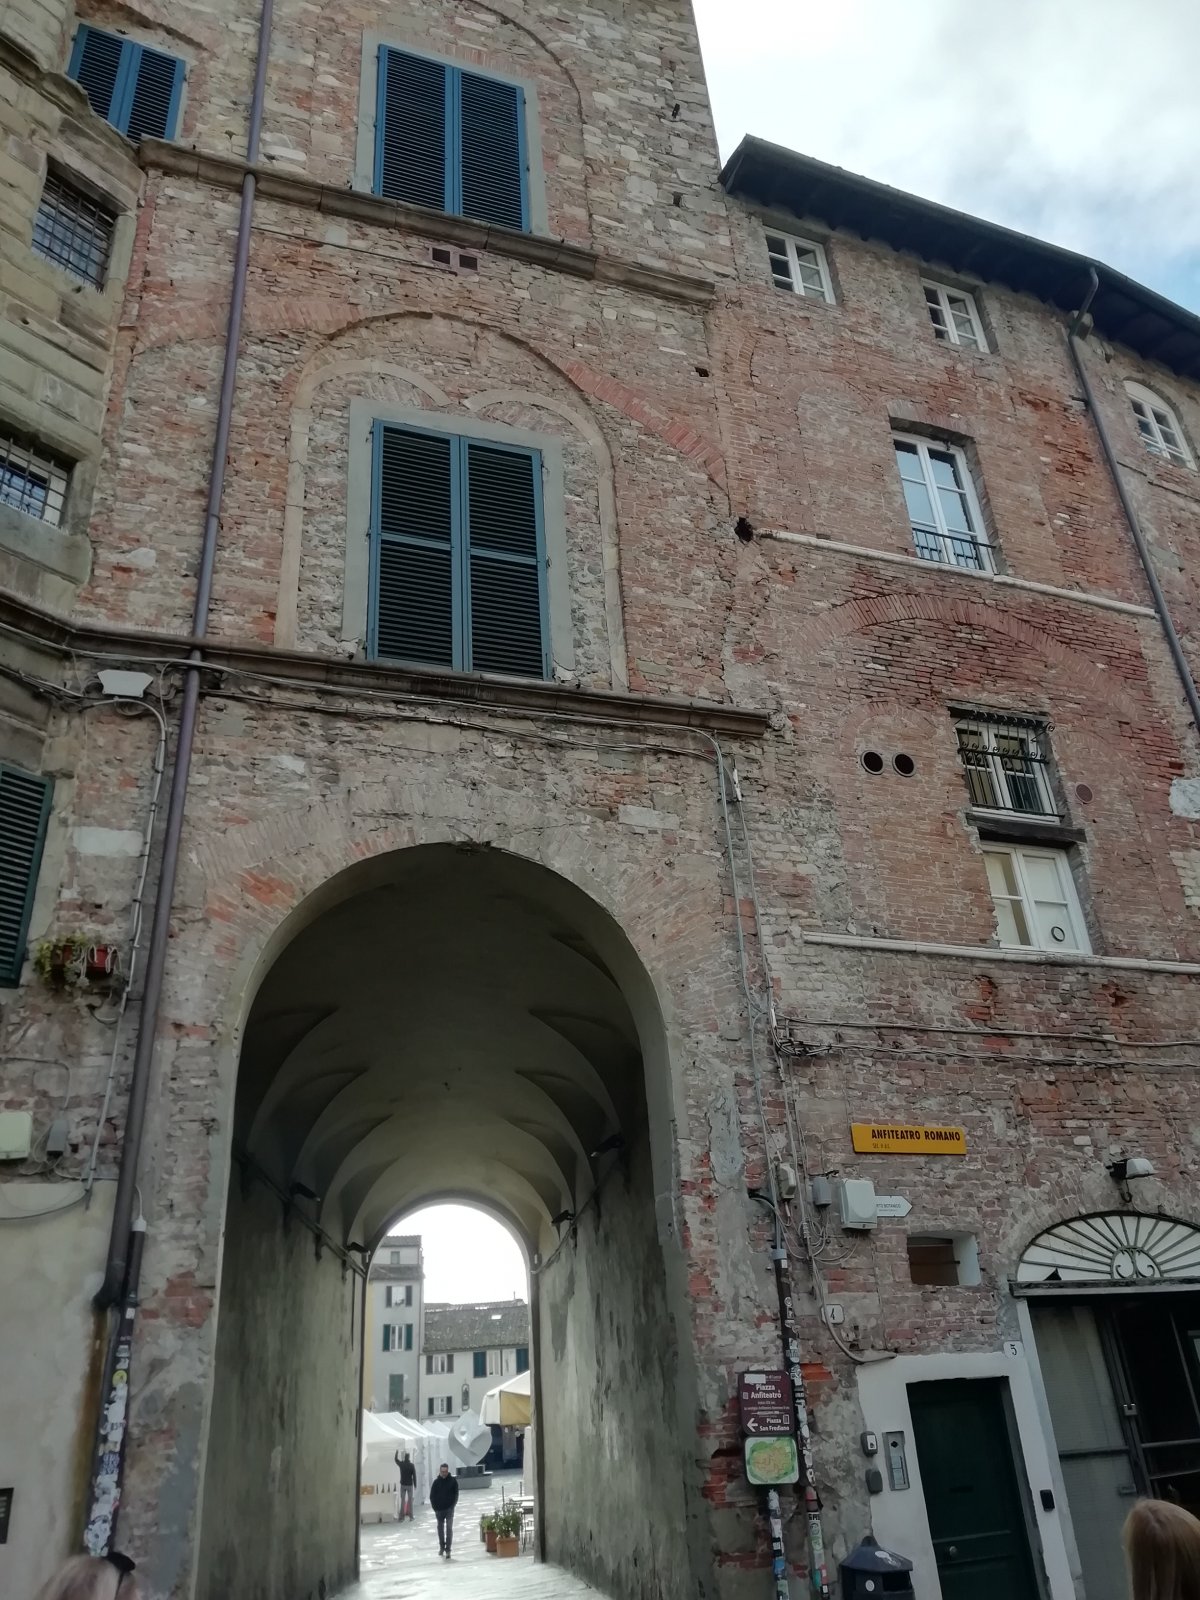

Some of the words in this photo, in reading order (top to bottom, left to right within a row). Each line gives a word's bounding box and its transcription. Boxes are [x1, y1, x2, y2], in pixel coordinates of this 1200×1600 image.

[871, 1129, 921, 1140] ANFITEATRO
[924, 1131, 961, 1141] ROMANO
[830, 1308, 835, 1320] 4
[1010, 1344, 1017, 1355] 5
